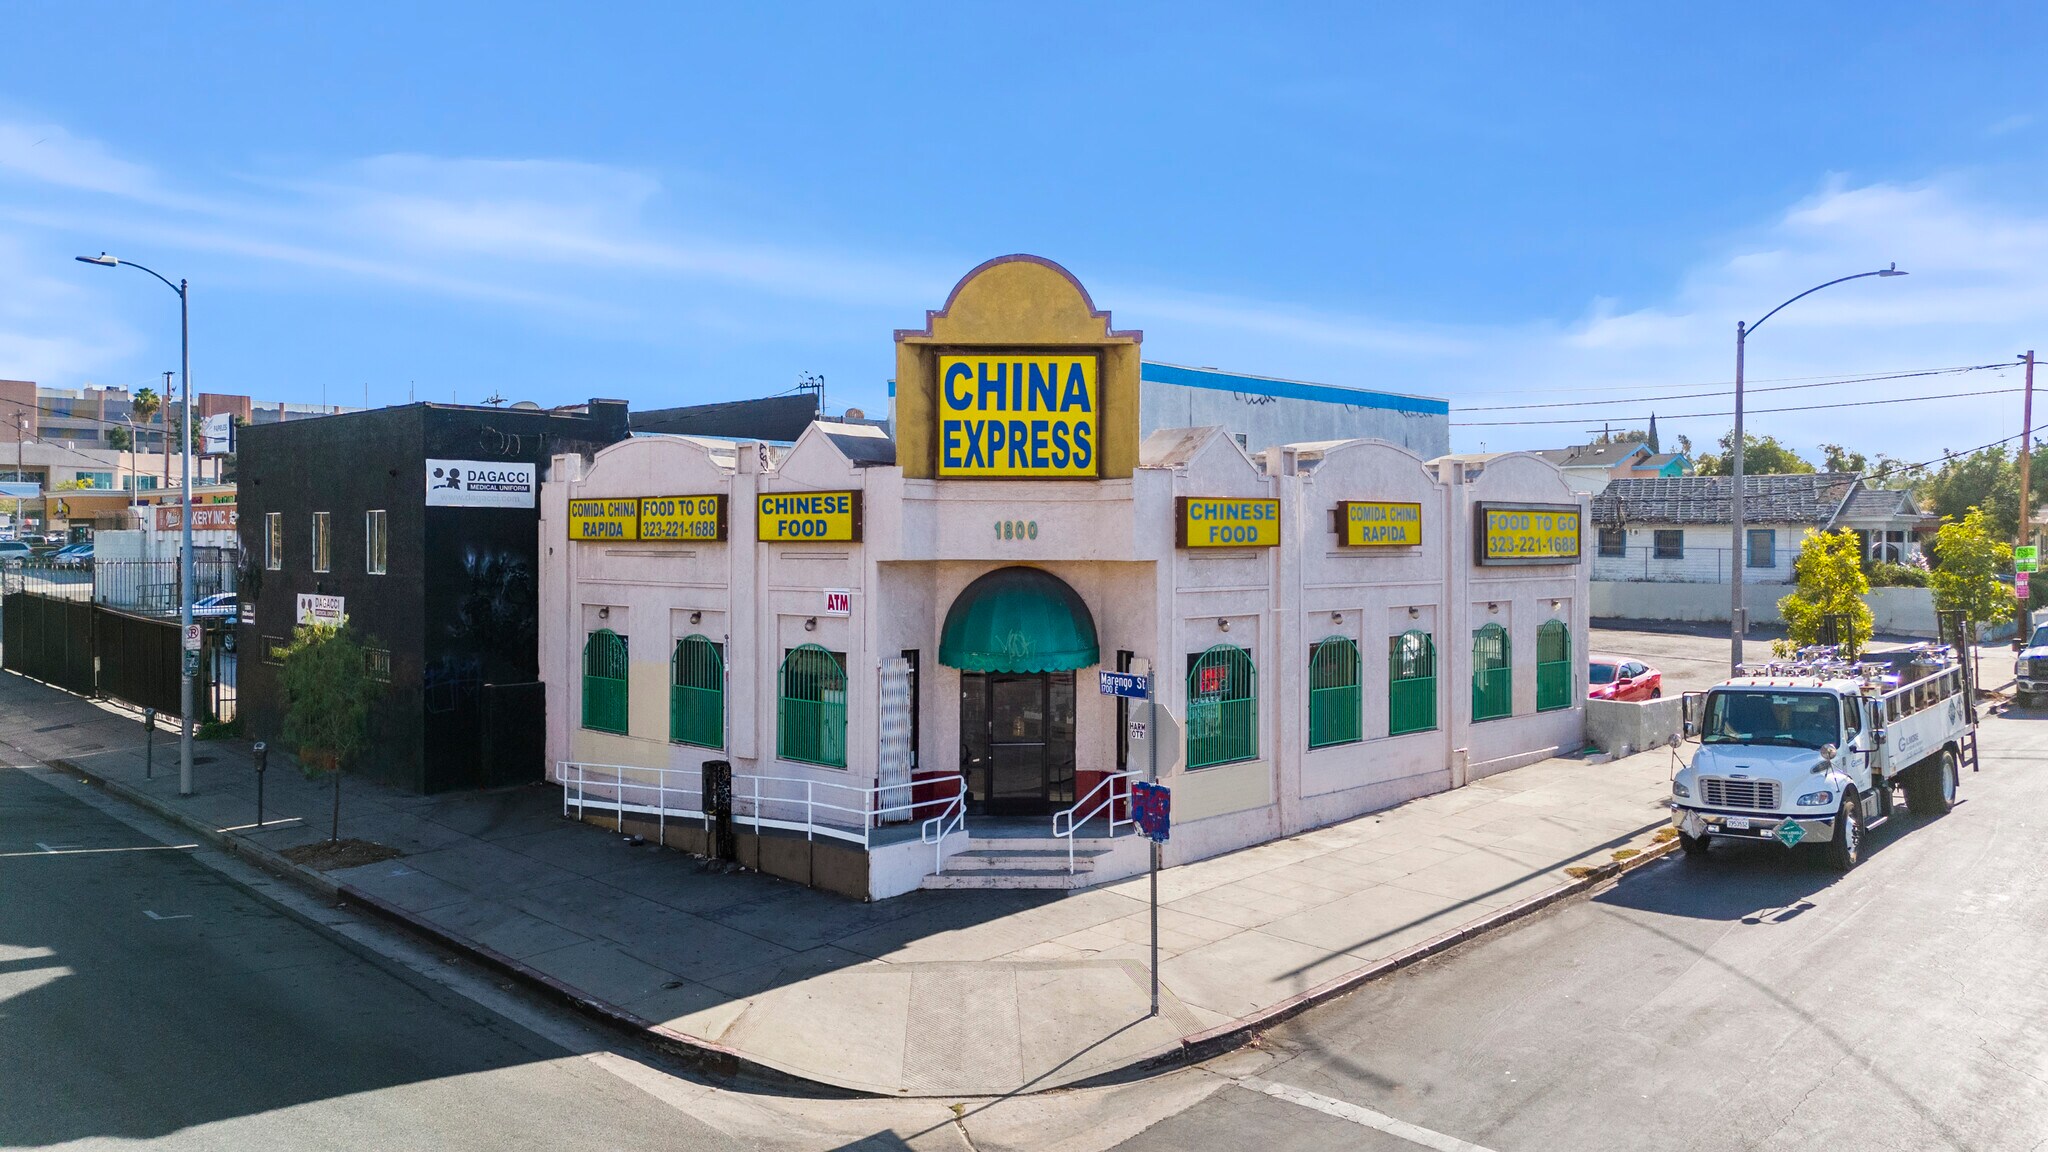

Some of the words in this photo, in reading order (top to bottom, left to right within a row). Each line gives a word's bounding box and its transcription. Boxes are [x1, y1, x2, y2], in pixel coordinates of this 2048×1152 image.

[944, 361, 1092, 413] CHINA
[943, 419, 1092, 469] EXPRESS
[467, 470, 529, 484] DAGACCI
[571, 502, 605, 518] COMIDA
[608, 502, 636, 517] CHINA
[643, 500, 675, 517] FOOD
[678, 500, 694, 516] TO
[698, 499, 716, 515] GO
[761, 496, 849, 515] CHINESE
[1190, 502, 1276, 521] CHINESE
[1350, 505, 1387, 521] COMIDA
[1390, 506, 1418, 522] CHINA
[191, 510, 213, 525] KERY
[1489, 514, 1530, 531] FOOD
[1535, 515, 1553, 531] TO
[1557, 516, 1577, 531] GO
[583, 521, 623, 537] RAPIDA
[642, 521, 716, 537] 323-221-1688
[778, 519, 828, 537] FOOD
[994, 520, 1039, 540] 1800
[1209, 525, 1258, 543] FOOD
[1362, 525, 1406, 542] RAPIDA
[1489, 536, 1577, 553] 323-221-1688
[315, 597, 340, 609] DAGACCI
[827, 593, 849, 612] ATM
[1101, 673, 1133, 691] Marengo
[1136, 677, 1146, 690] St
[1101, 684, 1113, 694] 1700
[1114, 685, 1119, 694] E
[1129, 722, 1146, 731] HARM
